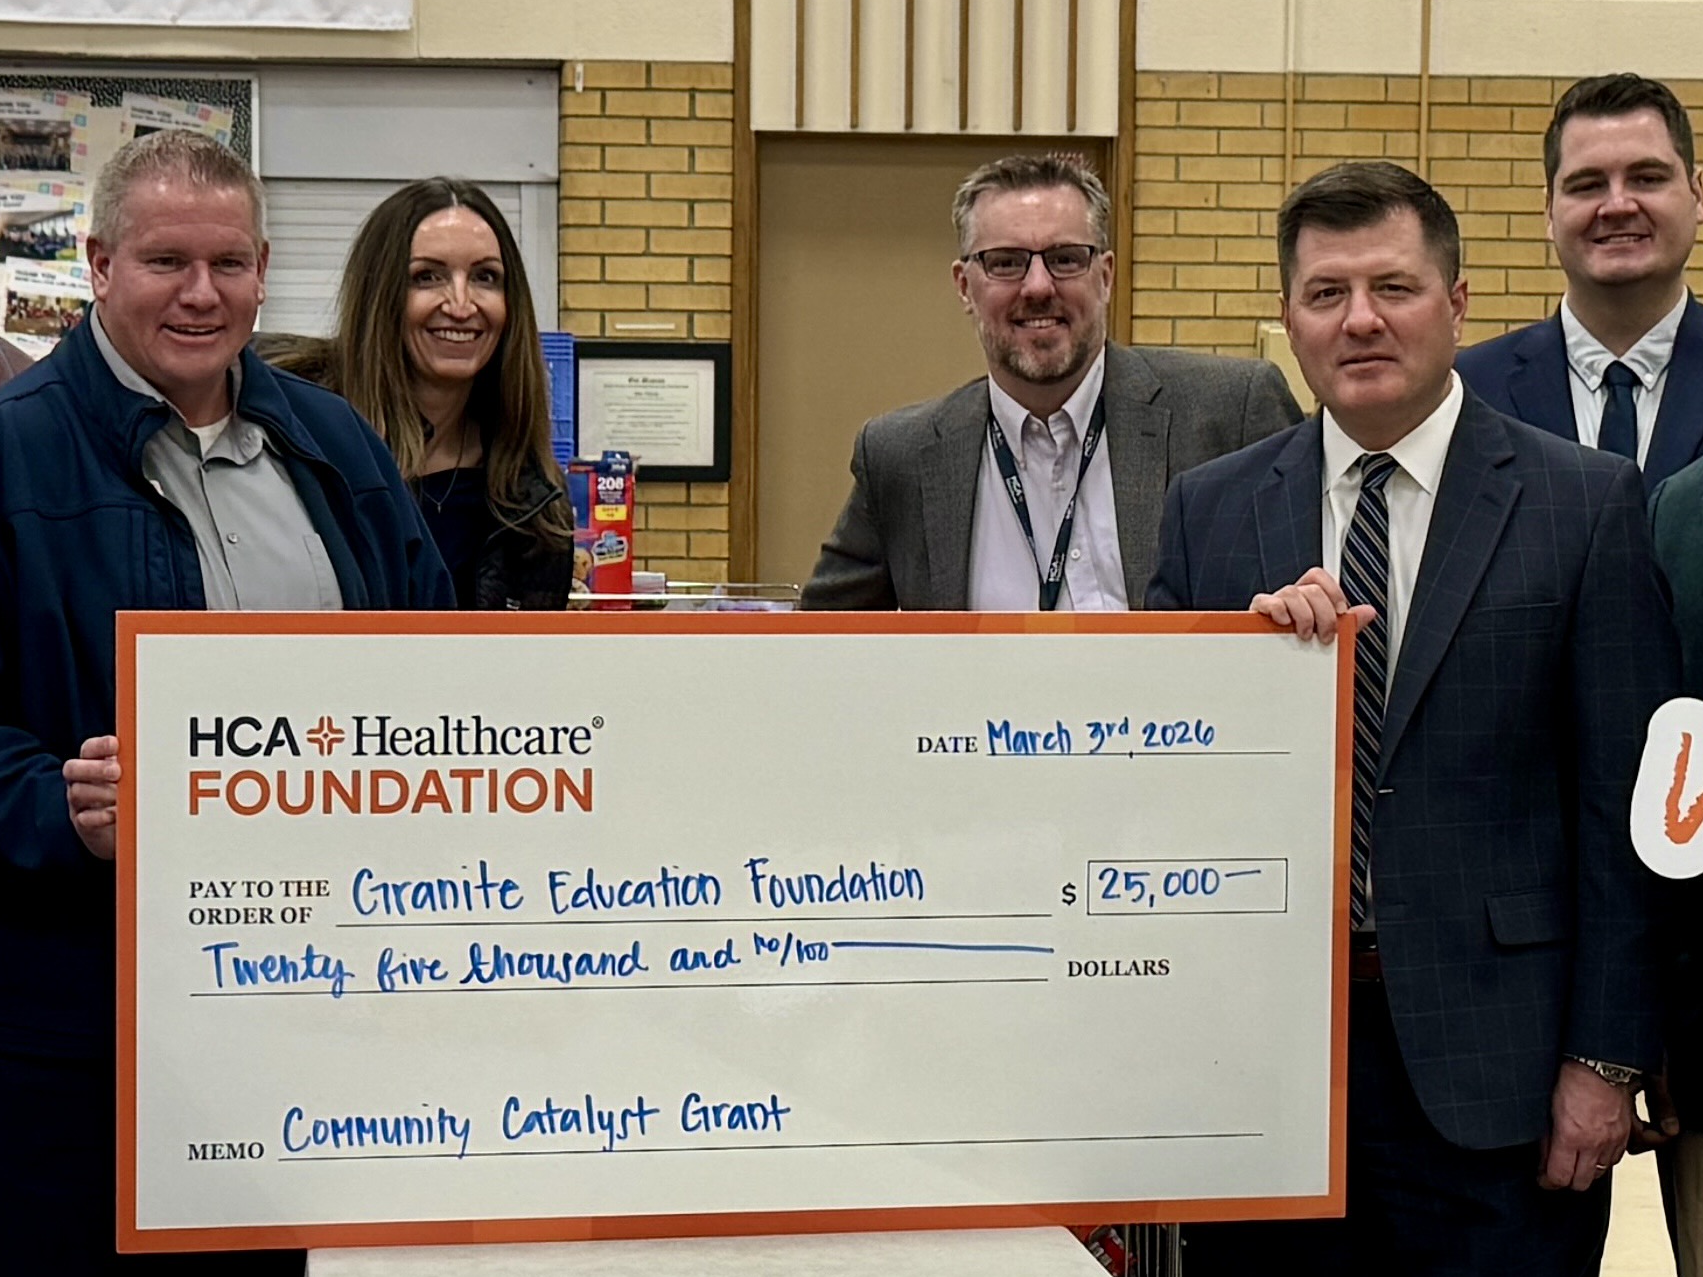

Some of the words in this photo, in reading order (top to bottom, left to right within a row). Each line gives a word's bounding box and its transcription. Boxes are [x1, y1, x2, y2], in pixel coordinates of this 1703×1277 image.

[189, 717, 301, 757] HCA
[917, 735, 978, 755] DATE
[985, 718, 1072, 756] March
[1142, 719, 1216, 748] 2026
[189, 768, 594, 816] FOUNDATION
[189, 880, 236, 899] PAY
[242, 880, 275, 898] TO
[279, 879, 330, 897] THE
[351, 860, 525, 917] Granite
[548, 865, 722, 915] Education
[744, 856, 925, 909] Foundation
[1062, 881, 1077, 906] $
[189, 908, 275, 925] ORDER
[280, 907, 313, 925] OF
[202, 940, 355, 999] Twenty
[376, 946, 449, 993] five
[459, 940, 650, 984] thousand
[669, 937, 741, 973] and
[1067, 959, 1170, 980] DOLLARS
[283, 1103, 472, 1159] Community
[502, 1094, 660, 1153] Catalyst
[680, 1092, 791, 1133] Grant
[188, 1142, 265, 1161] MEMO
